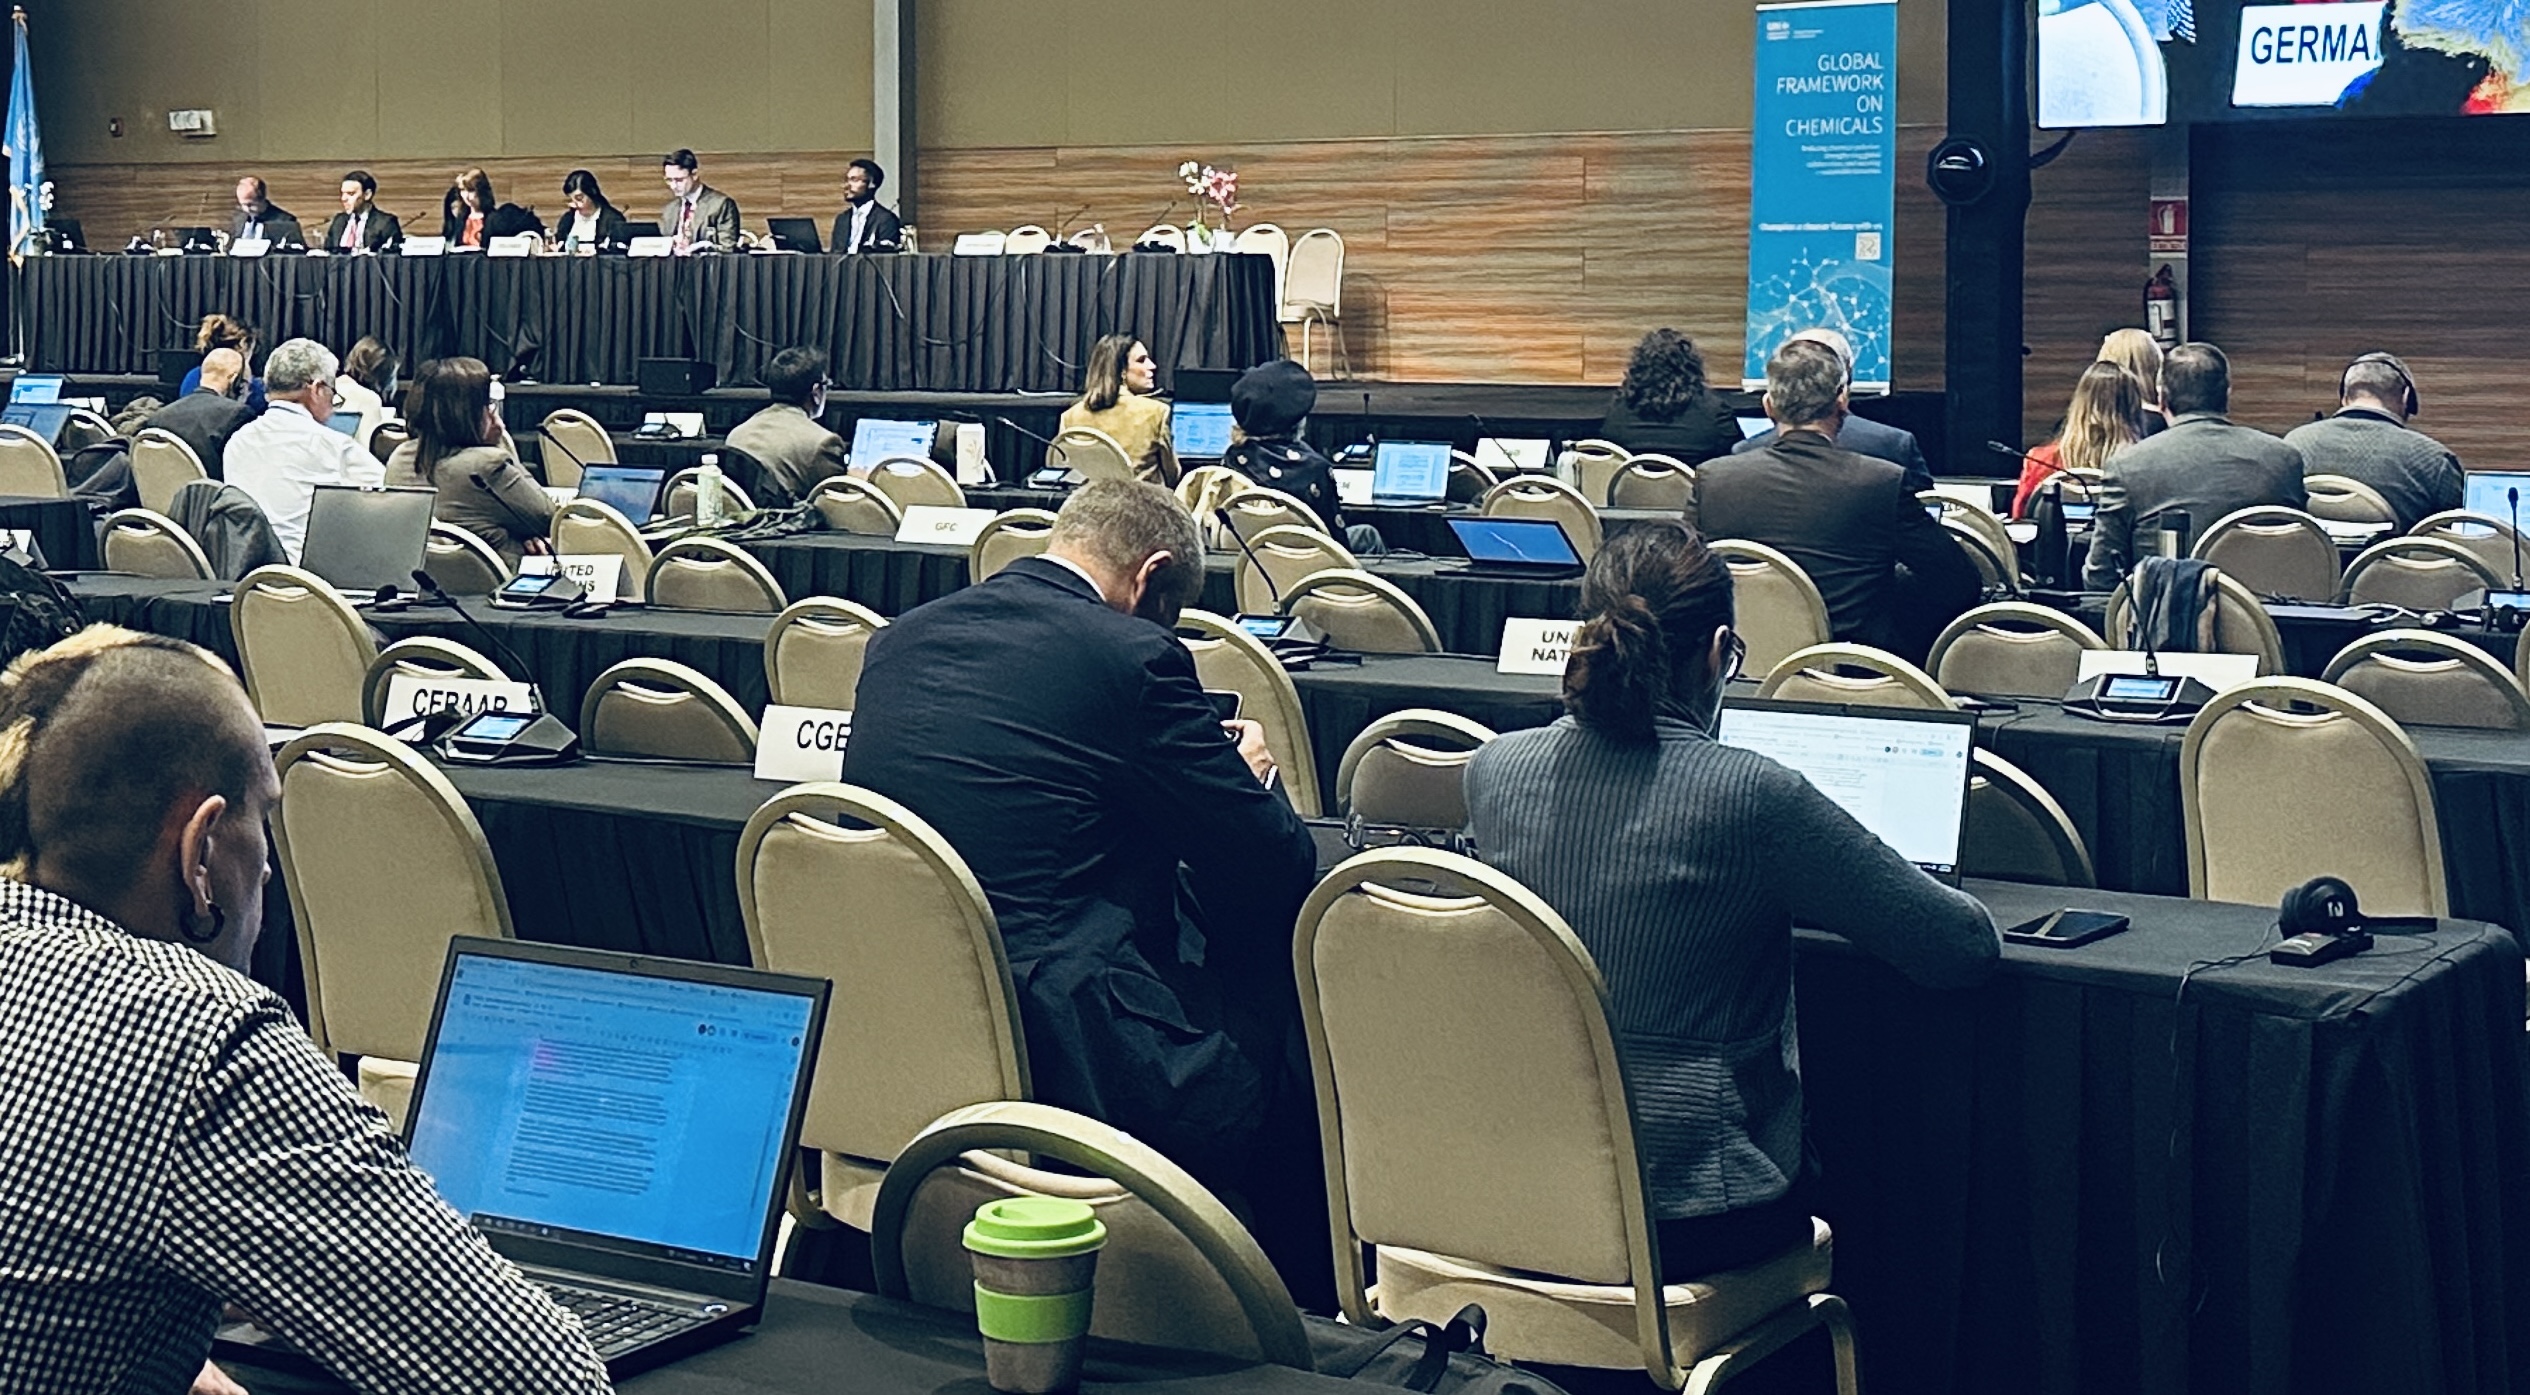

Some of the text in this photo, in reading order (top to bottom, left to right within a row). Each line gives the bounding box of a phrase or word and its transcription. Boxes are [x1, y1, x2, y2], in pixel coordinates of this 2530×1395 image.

[2251, 23, 2379, 64] GERMA
[1818, 52, 1884, 72] GLOBAL
[1777, 73, 1884, 94] FRAMEWORK
[1856, 94, 1883, 113] ON
[1785, 116, 1883, 137] CHEMICALS
[935, 522, 958, 531] GFC
[1541, 630, 1570, 644] UN
[797, 719, 852, 752] CGE
